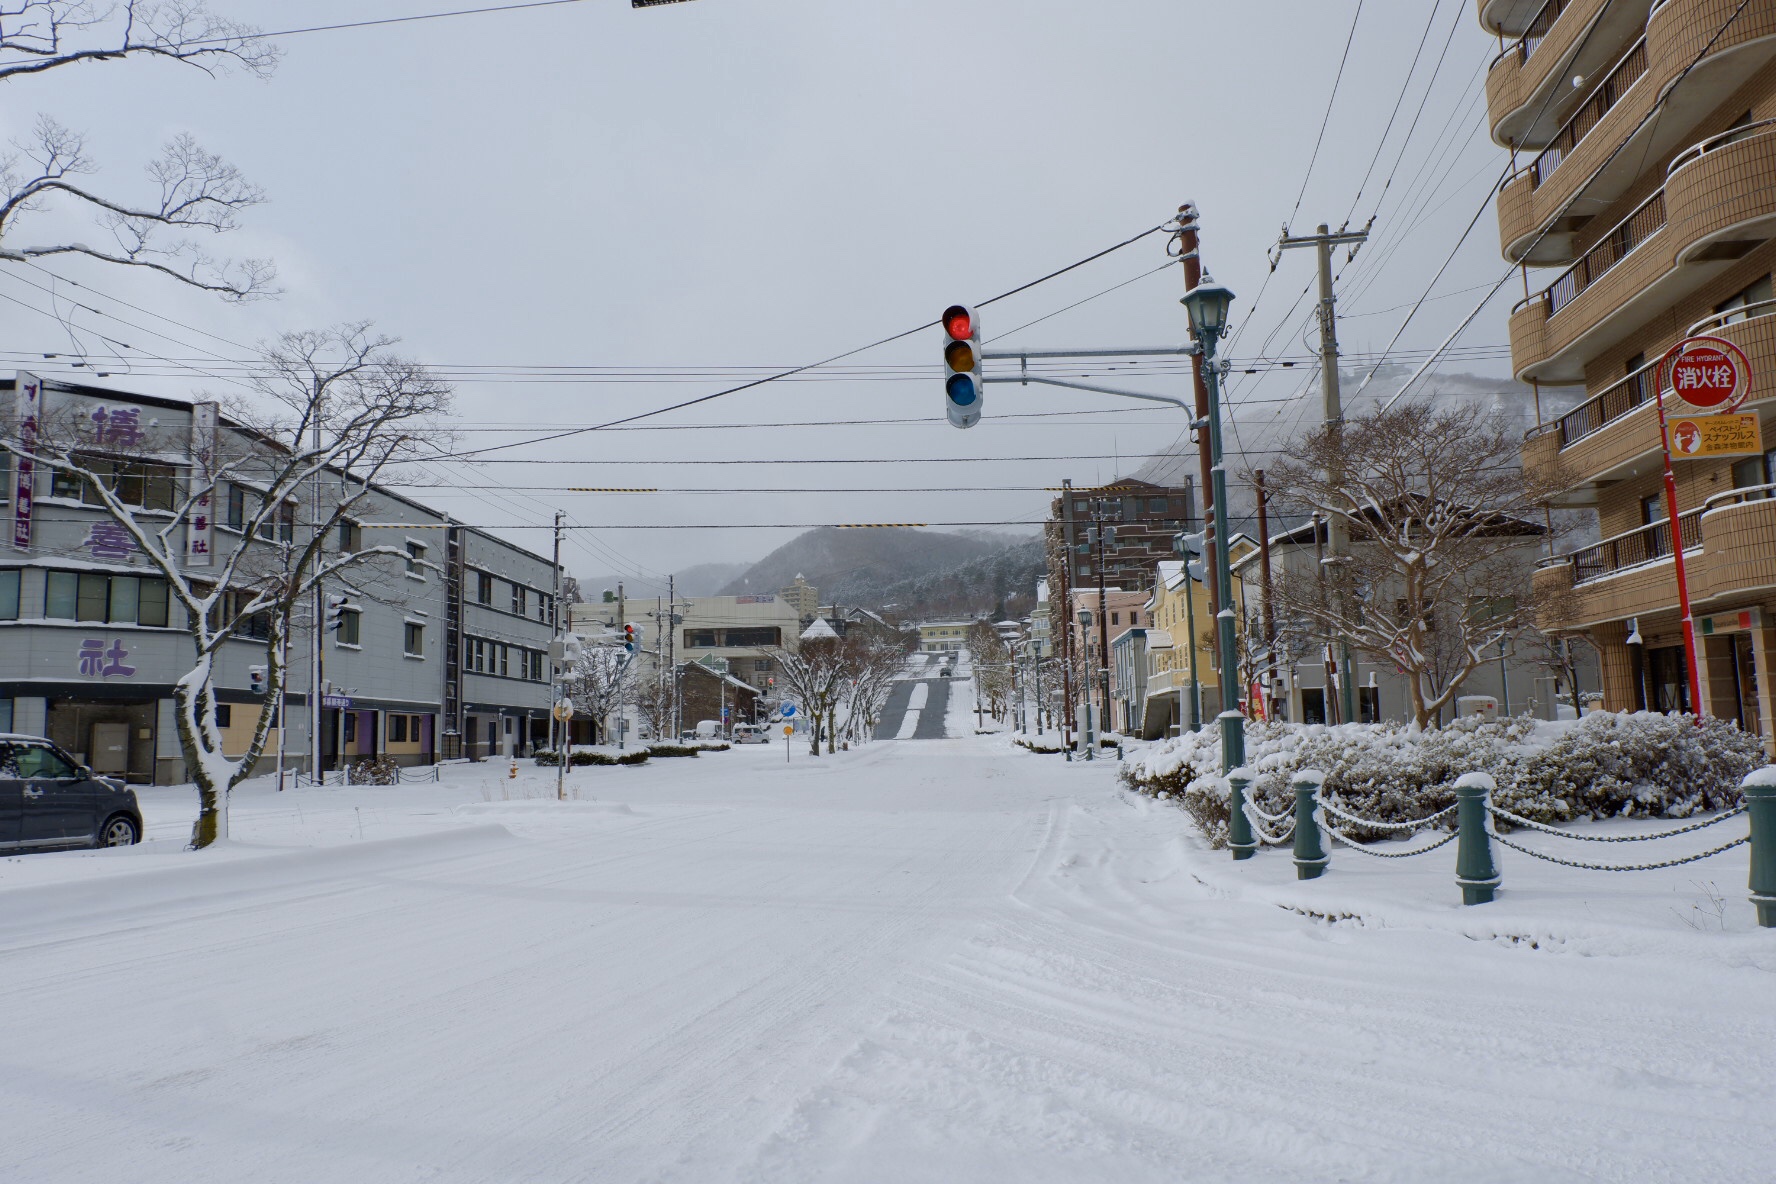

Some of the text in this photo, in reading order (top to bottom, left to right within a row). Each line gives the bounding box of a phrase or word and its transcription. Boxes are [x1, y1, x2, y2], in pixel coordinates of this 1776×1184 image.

[1681, 354, 1724, 363] FIRE HYDRANT
[1677, 364, 1732, 390] 消火栓
[1703, 430, 1756, 443] スナッフルス
